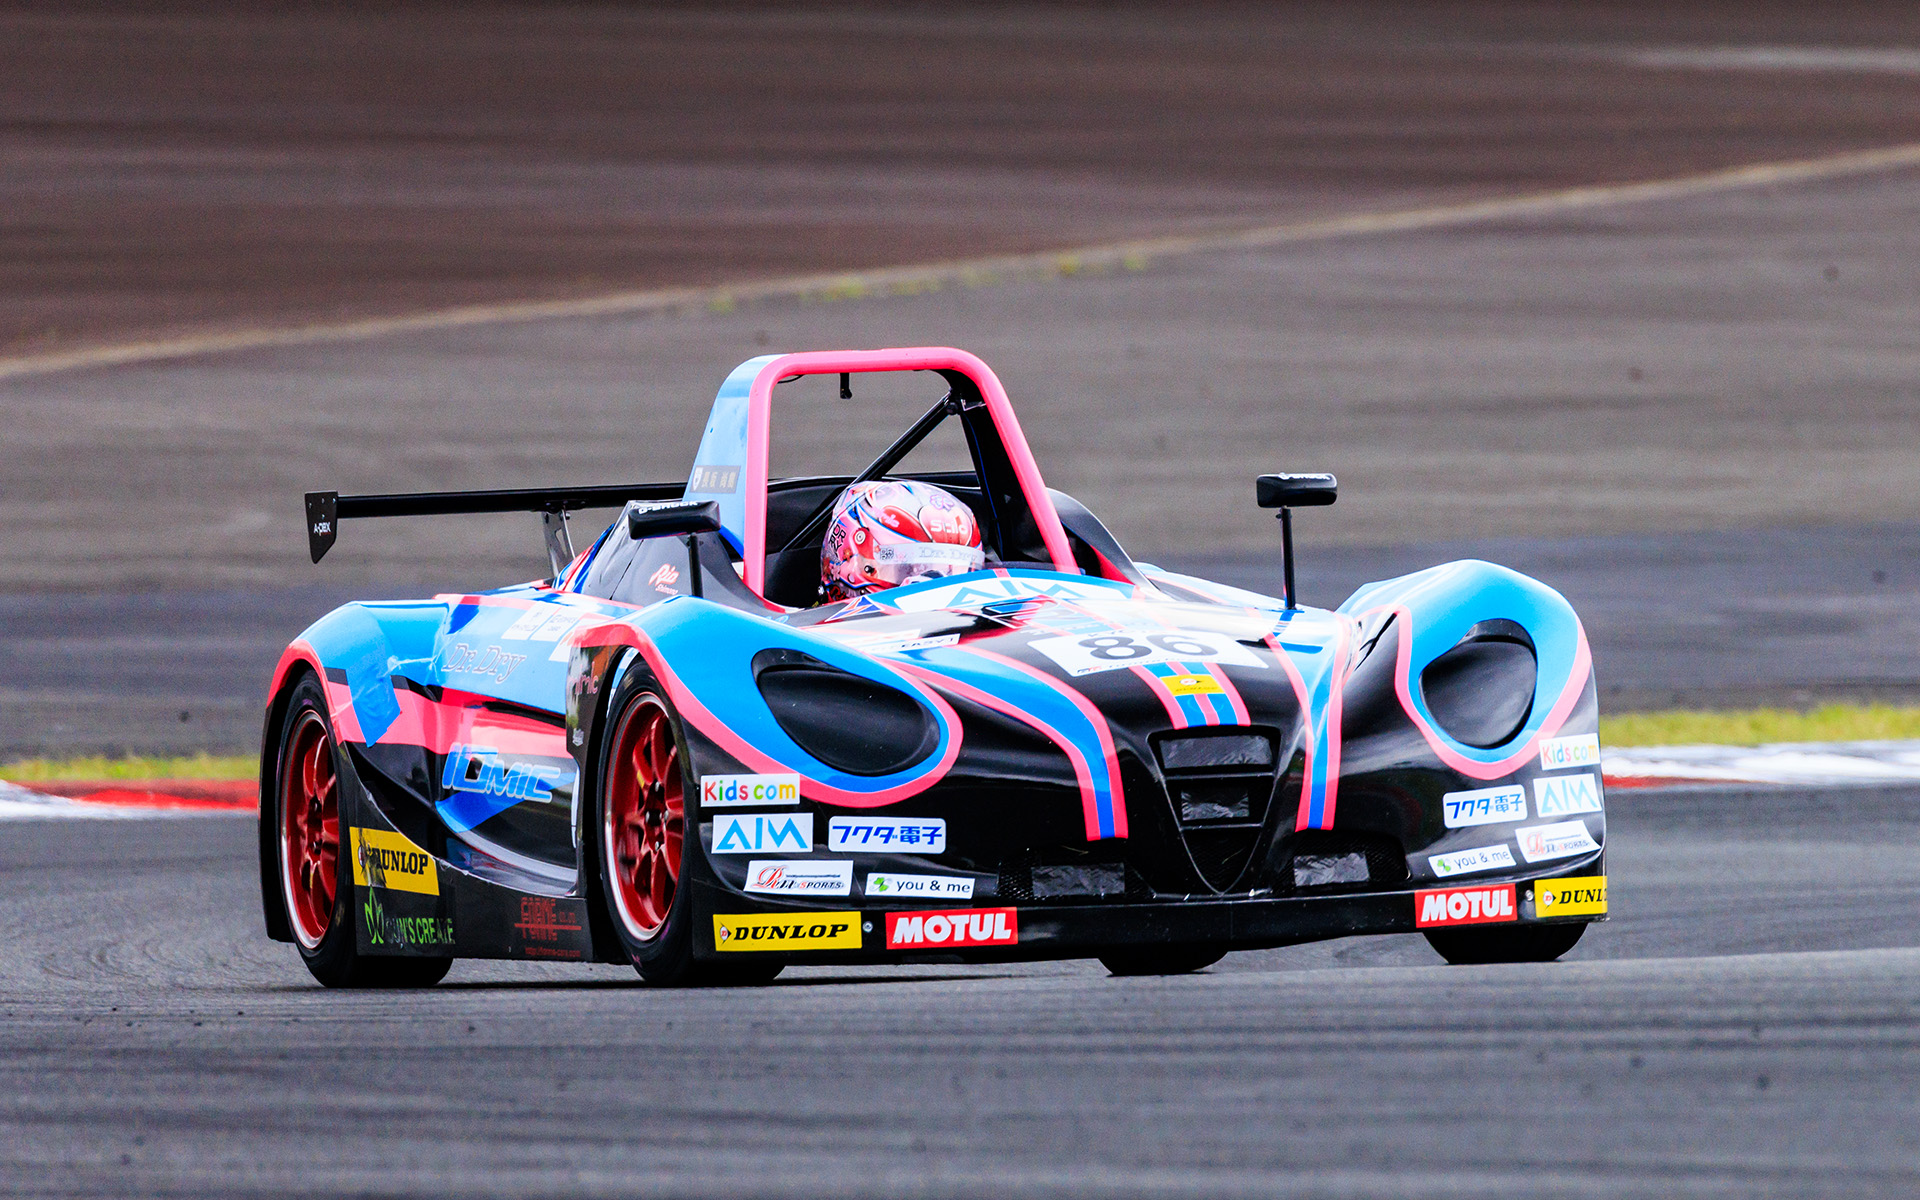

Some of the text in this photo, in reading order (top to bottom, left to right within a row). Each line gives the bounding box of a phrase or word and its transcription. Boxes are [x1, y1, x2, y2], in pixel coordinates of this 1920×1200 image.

[930, 515, 968, 535] Stilo
[1078, 633, 1218, 660] 86
[476, 647, 527, 685] Dry
[704, 779, 748, 802] Kids
[716, 817, 808, 850] AIM
[1454, 850, 1510, 869] you & me
[897, 880, 970, 893] you & me
[1421, 889, 1513, 922] MOTUL
[733, 923, 849, 942] DUNLOP
[892, 913, 1012, 944] MOTUL
